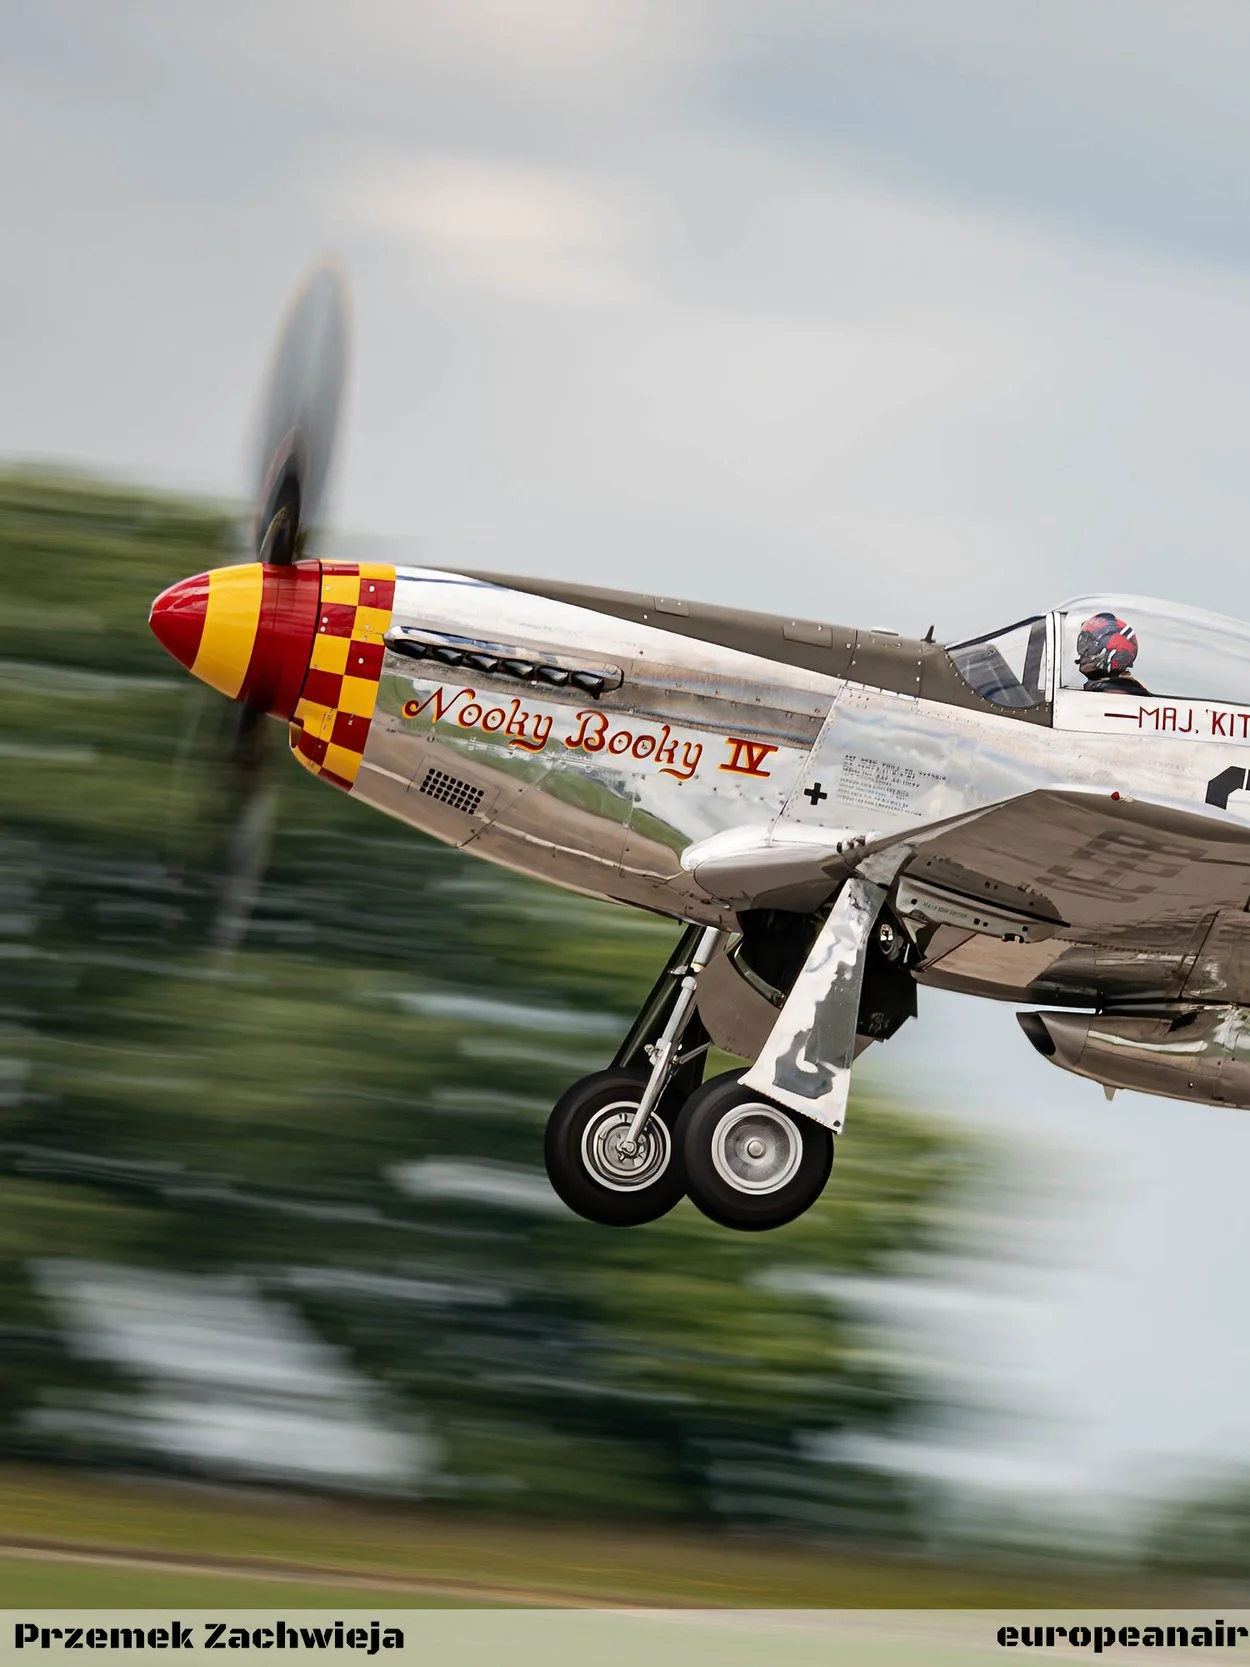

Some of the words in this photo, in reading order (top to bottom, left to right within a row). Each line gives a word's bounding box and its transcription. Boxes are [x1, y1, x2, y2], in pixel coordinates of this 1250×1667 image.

[402, 687, 553, 753] Nooky
[564, 709, 703, 780] Booky
[718, 737, 779, 777] IV
